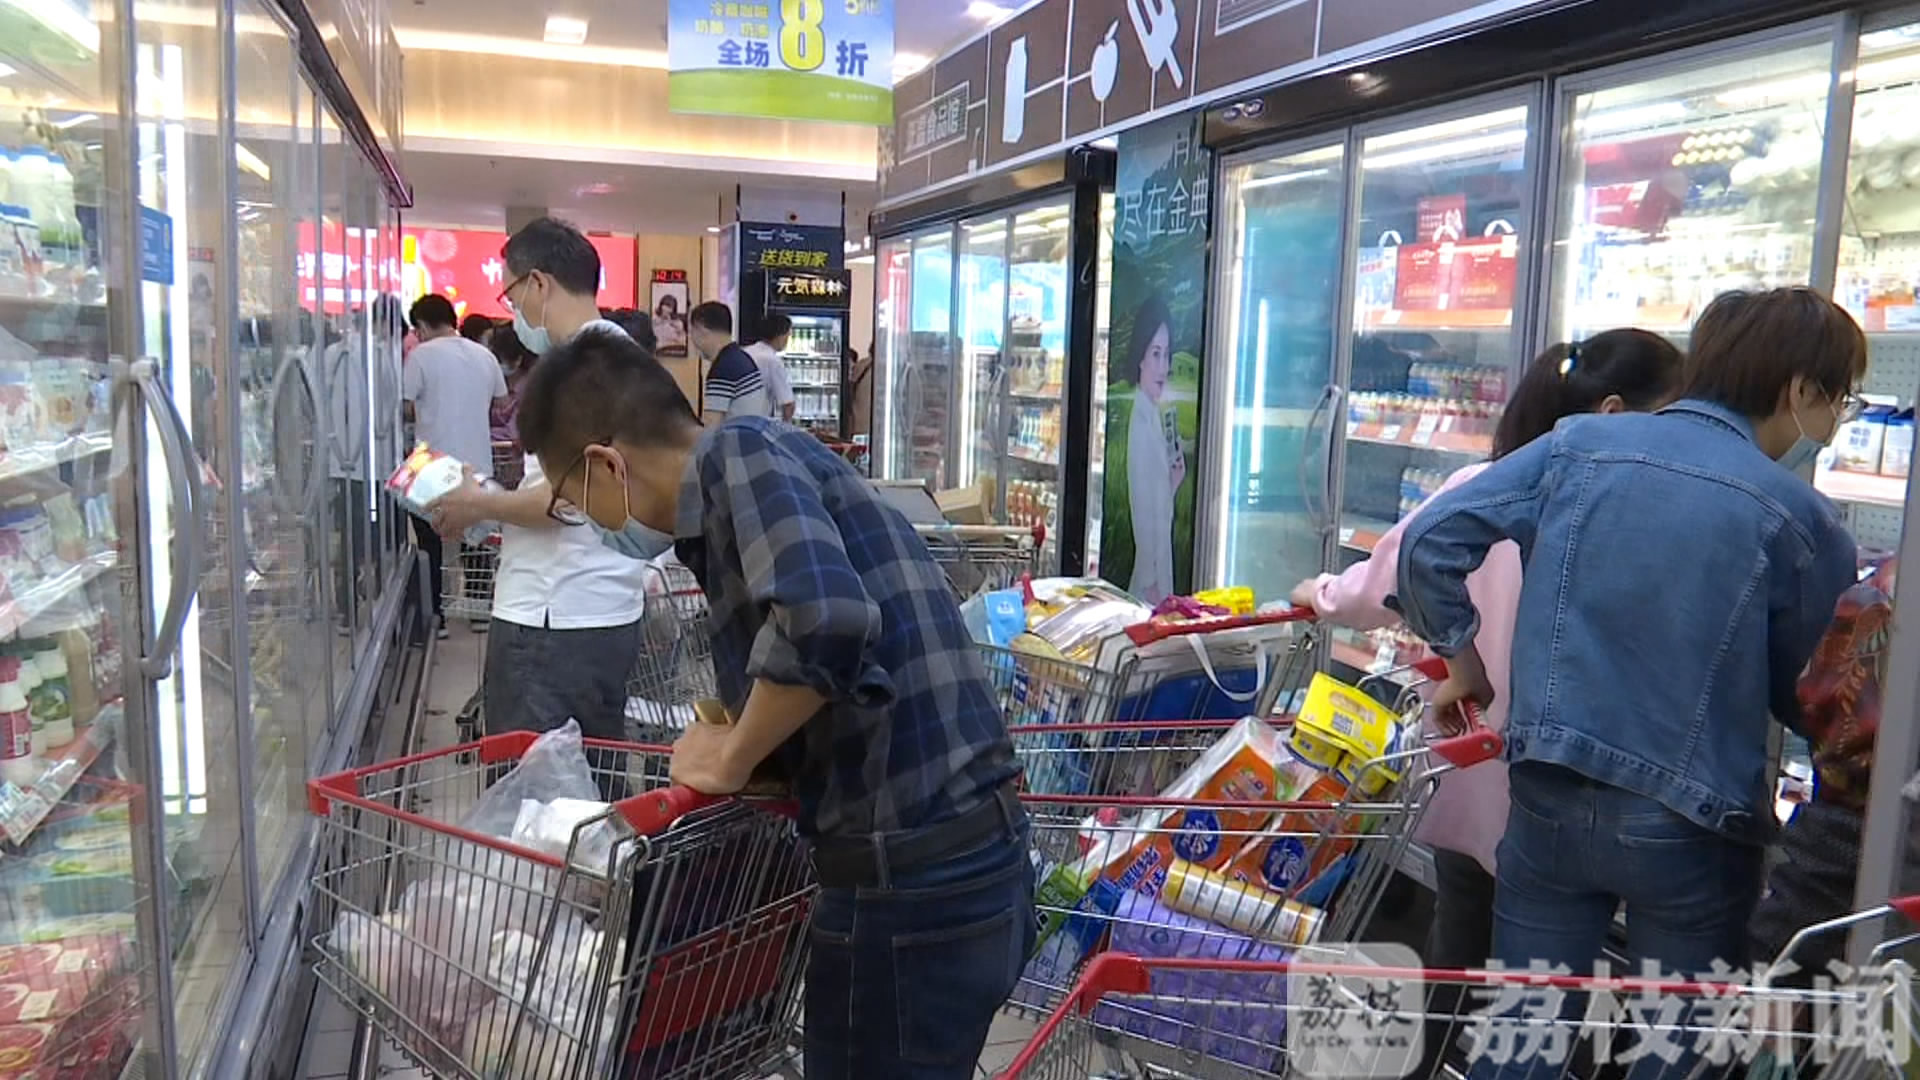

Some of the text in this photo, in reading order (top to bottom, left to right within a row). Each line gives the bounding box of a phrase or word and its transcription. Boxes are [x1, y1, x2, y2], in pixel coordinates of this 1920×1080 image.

[717, 0, 868, 76] 全场 8 折
[1120, 171, 1208, 241] 尽在金典
[758, 248, 828, 268] 送货到家
